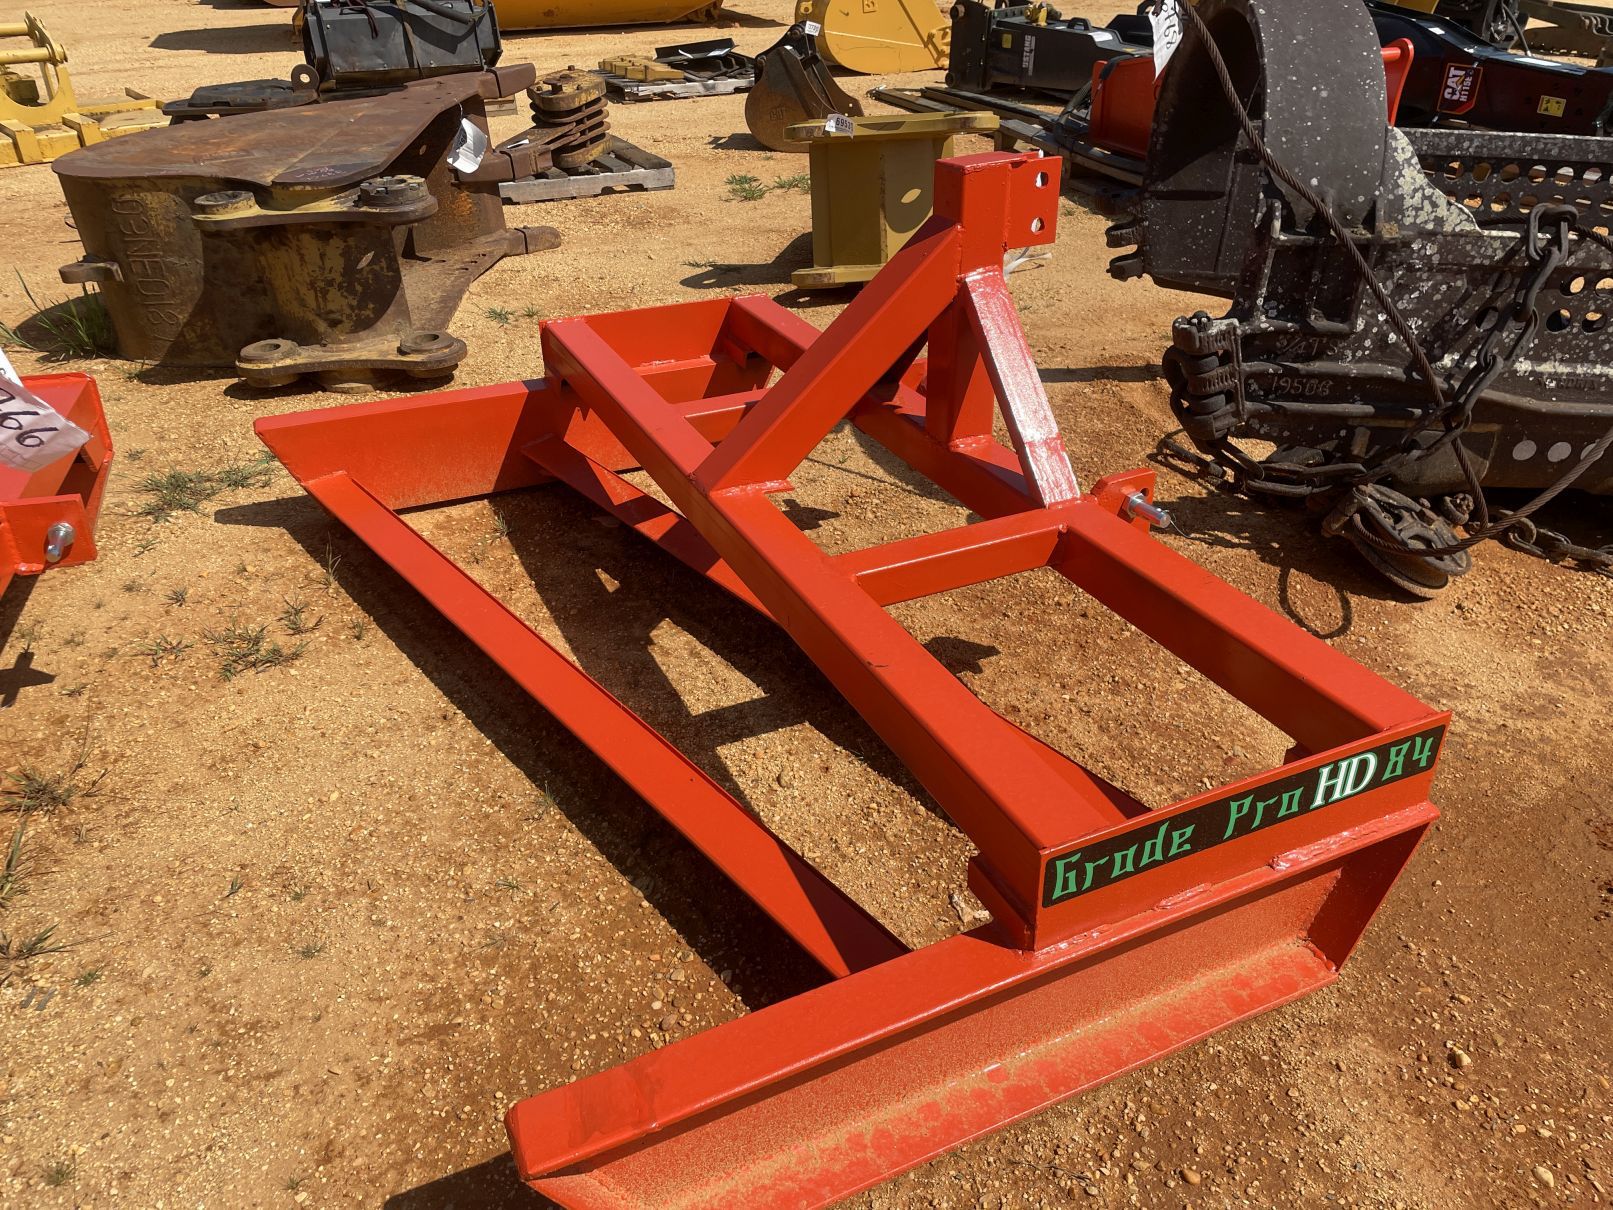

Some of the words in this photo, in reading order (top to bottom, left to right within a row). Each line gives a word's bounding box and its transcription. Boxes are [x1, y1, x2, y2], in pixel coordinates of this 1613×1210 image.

[1443, 67, 1467, 101] CAT
[1052, 821, 1196, 900] Grade
[1223, 787, 1304, 840] Pro
[1309, 751, 1378, 810] HD
[1382, 736, 1434, 782] 84
